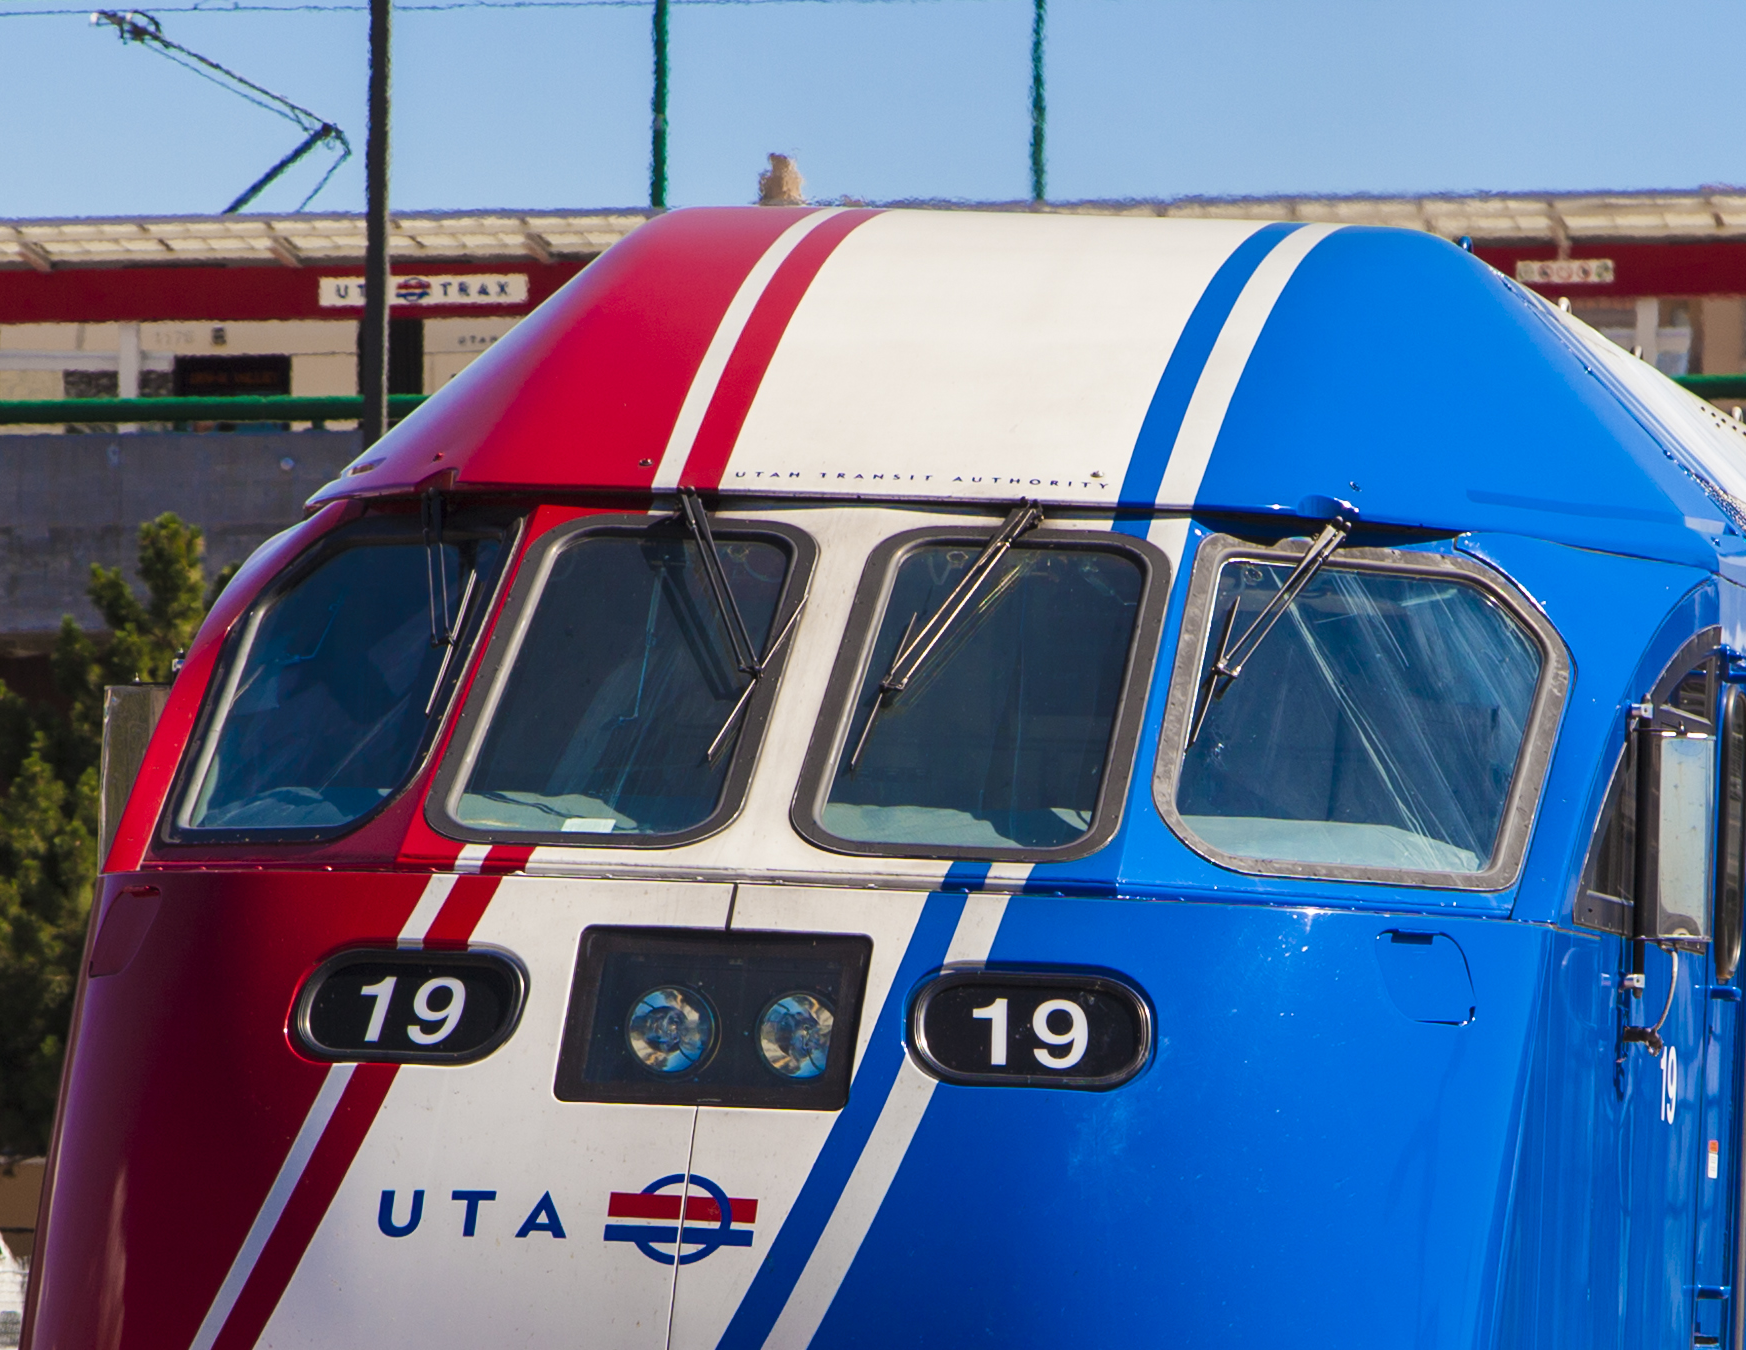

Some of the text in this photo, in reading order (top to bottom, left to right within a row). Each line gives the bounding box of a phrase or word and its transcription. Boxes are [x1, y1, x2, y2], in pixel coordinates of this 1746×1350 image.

[439, 281, 510, 297] TRAX
[735, 471, 1110, 490] UTAH TRANSIT AUTHORITY
[358, 974, 466, 1046] 19
[971, 997, 1090, 1070] 19
[1660, 1045, 1677, 1125] 19
[377, 1189, 566, 1240] UTA
